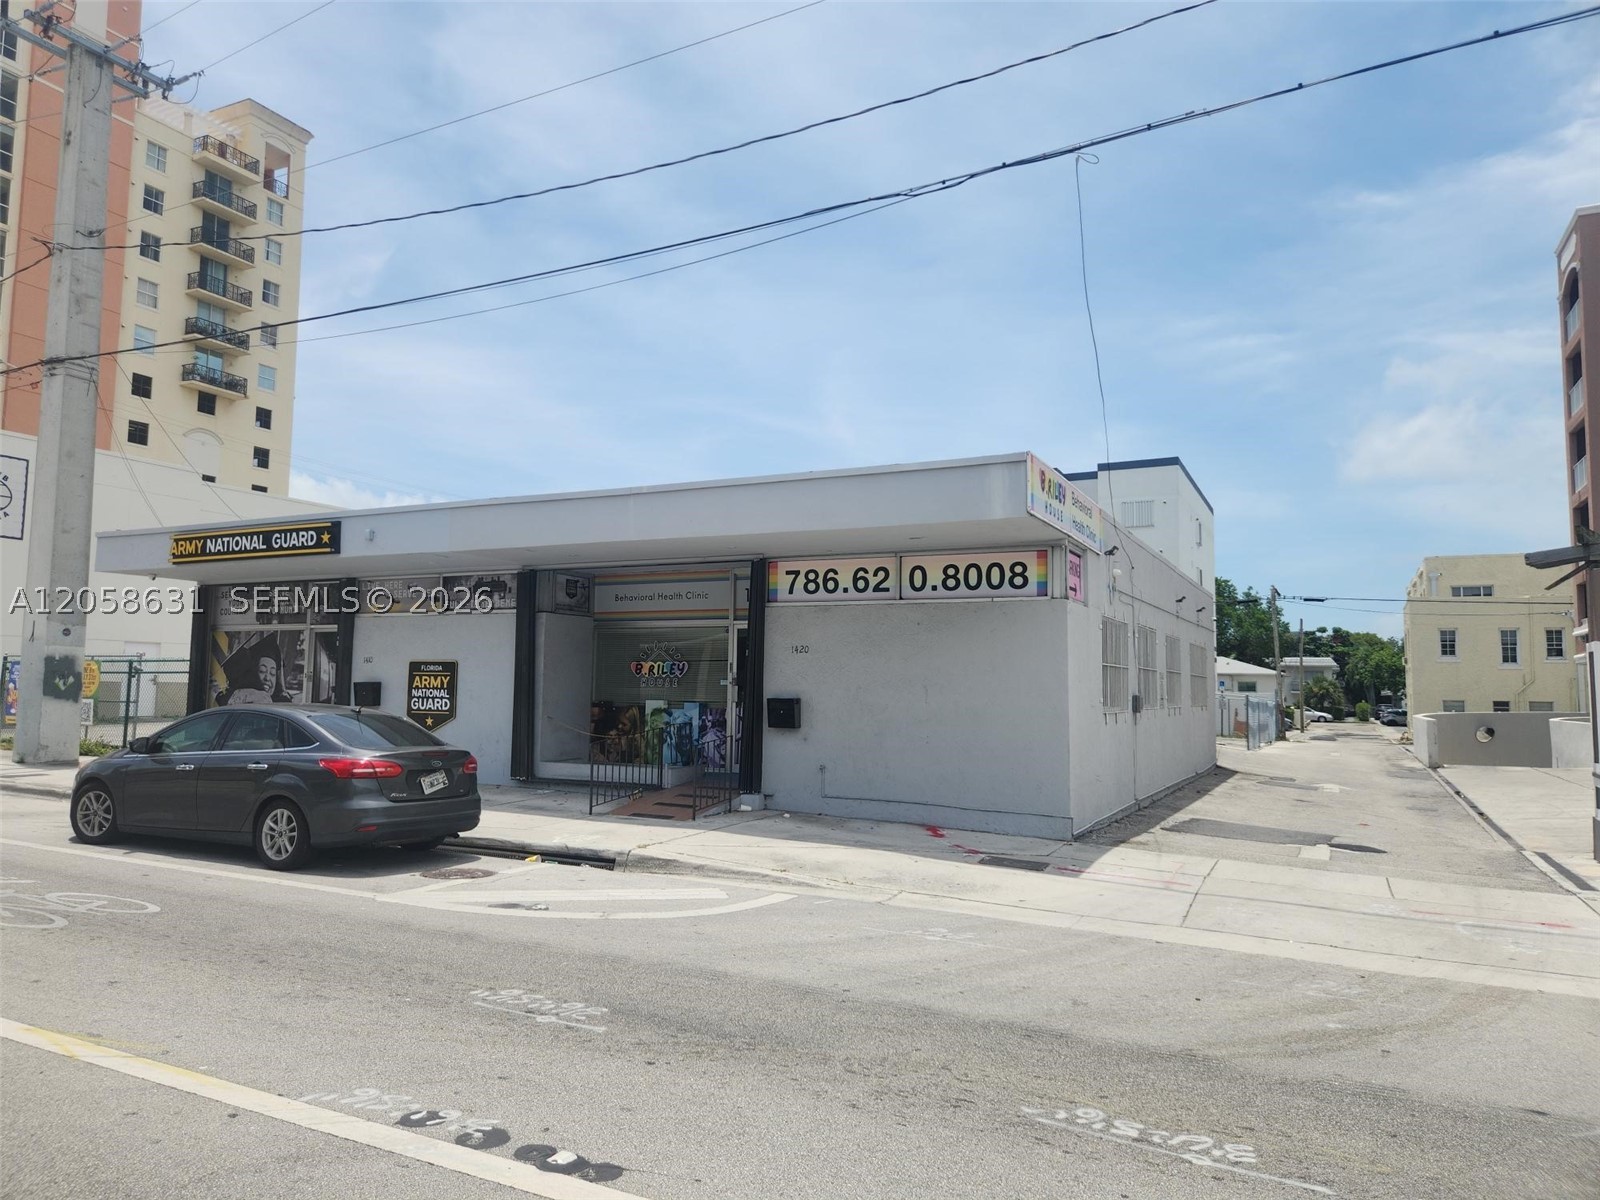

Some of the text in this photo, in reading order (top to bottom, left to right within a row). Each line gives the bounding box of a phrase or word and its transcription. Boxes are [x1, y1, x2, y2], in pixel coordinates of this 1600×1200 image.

[1071, 490, 1093, 520] Behavioral
[1045, 500, 1064, 523] HOUSE
[1072, 514, 1086, 537] Health
[170, 530, 317, 556] ARMY NATIONAL GUARD
[614, 590, 709, 602] Behavioral Health Clinic
[791, 645, 810, 654] 1420
[634, 662, 686, 677] B.RILEY
[412, 676, 450, 688] ARMY
[640, 678, 679, 687] HOUSE
[411, 688, 450, 697] NATIONAL
[410, 698, 450, 710] GUARD
